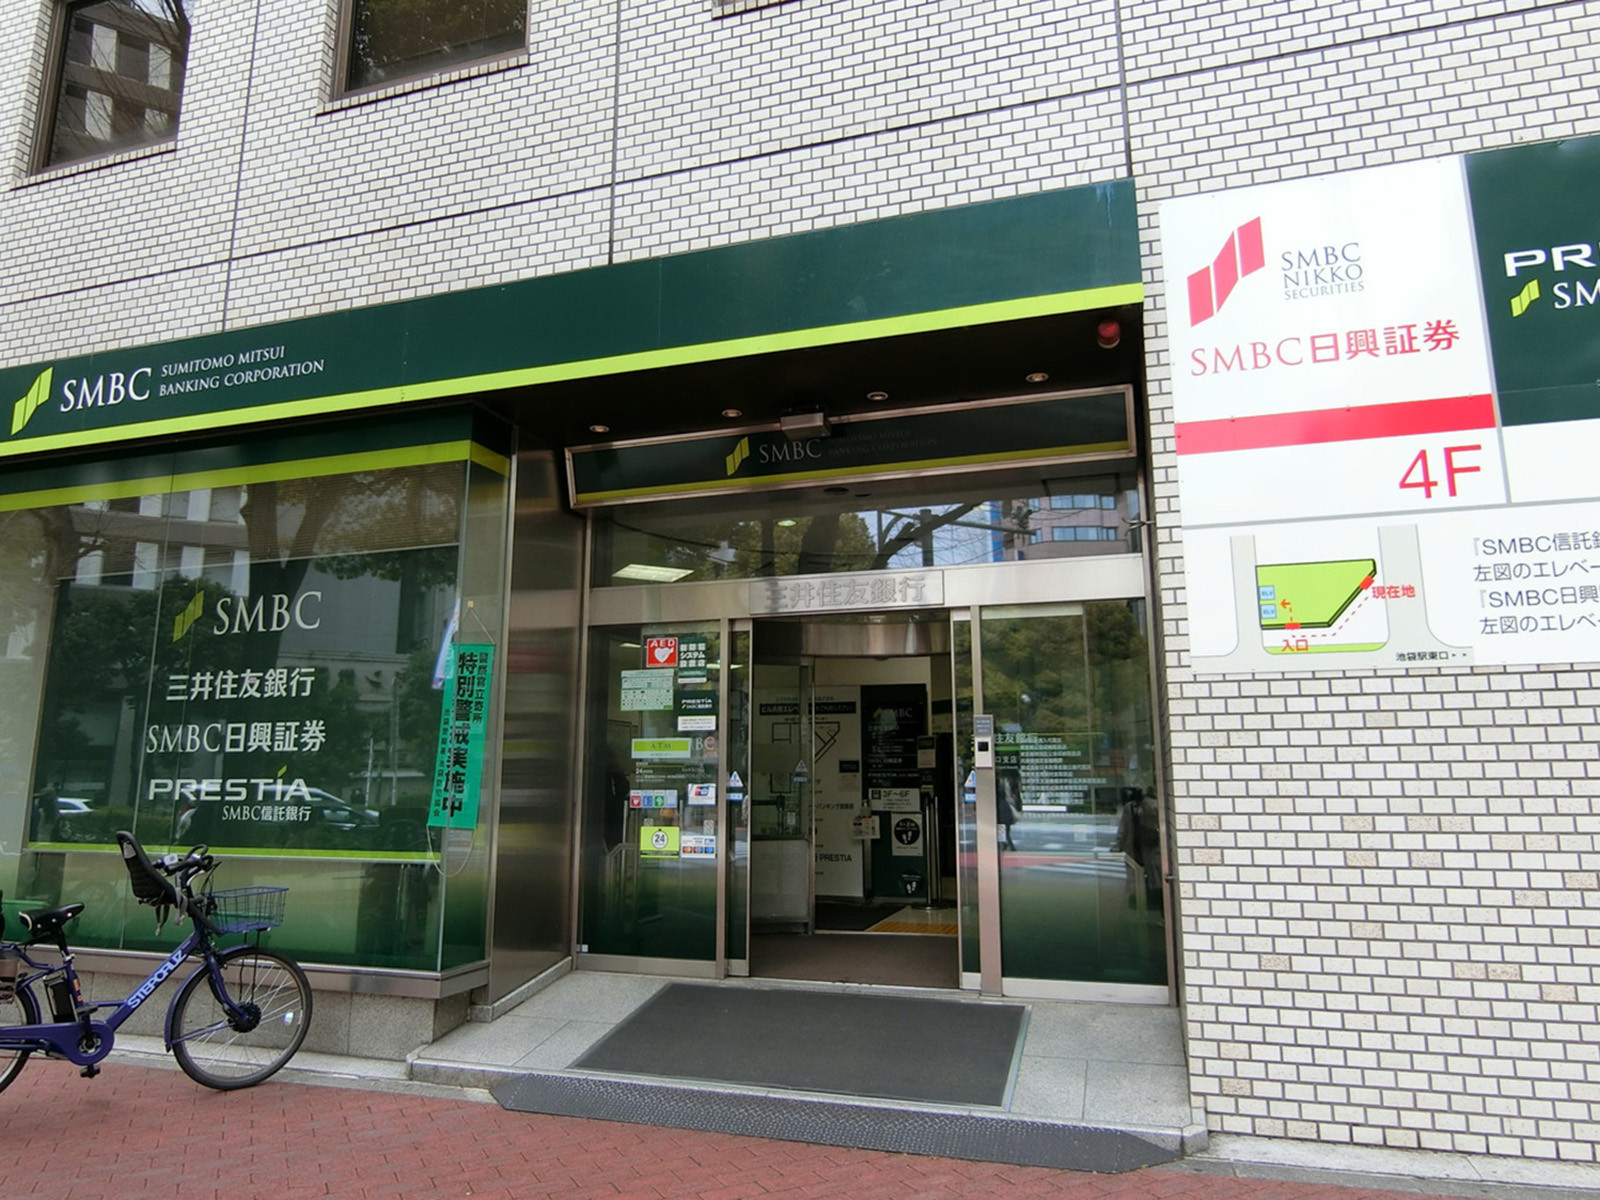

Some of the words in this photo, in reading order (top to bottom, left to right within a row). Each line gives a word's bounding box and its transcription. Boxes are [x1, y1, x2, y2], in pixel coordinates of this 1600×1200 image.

[1282, 242, 1361, 272] SMBC
[1504, 243, 1600, 277] PR
[1284, 264, 1363, 290] NIKKO
[1285, 281, 1365, 301] SECURITIES
[161, 353, 235, 377] SUMITOMO
[238, 346, 286, 365] MITSUI
[1190, 319, 1460, 377] SMBC日興証券
[60, 367, 152, 413] SMBC
[159, 376, 220, 397] BANKING
[225, 359, 325, 387] CORPORATION
[759, 439, 822, 465] SMBC
[1399, 444, 1482, 499] 4F
[765, 576, 925, 610] 三井住友銀行
[1372, 585, 1416, 599] 現在地
[1480, 585, 1600, 608] 『SMBC日興
[213, 591, 322, 636] SMBC
[1479, 612, 1600, 635] 左図のエレベ
[650, 639, 675, 648] AED
[1282, 639, 1309, 651] 入口
[1396, 651, 1449, 662] 池袋駅東口
[166, 668, 315, 701] 三井住友銀行
[146, 720, 326, 753] SMBC日興証券
[222, 805, 312, 822] SMBC信託銀行
[654, 834, 666, 843] 24
[127, 949, 187, 1008] STEPCRUZ
